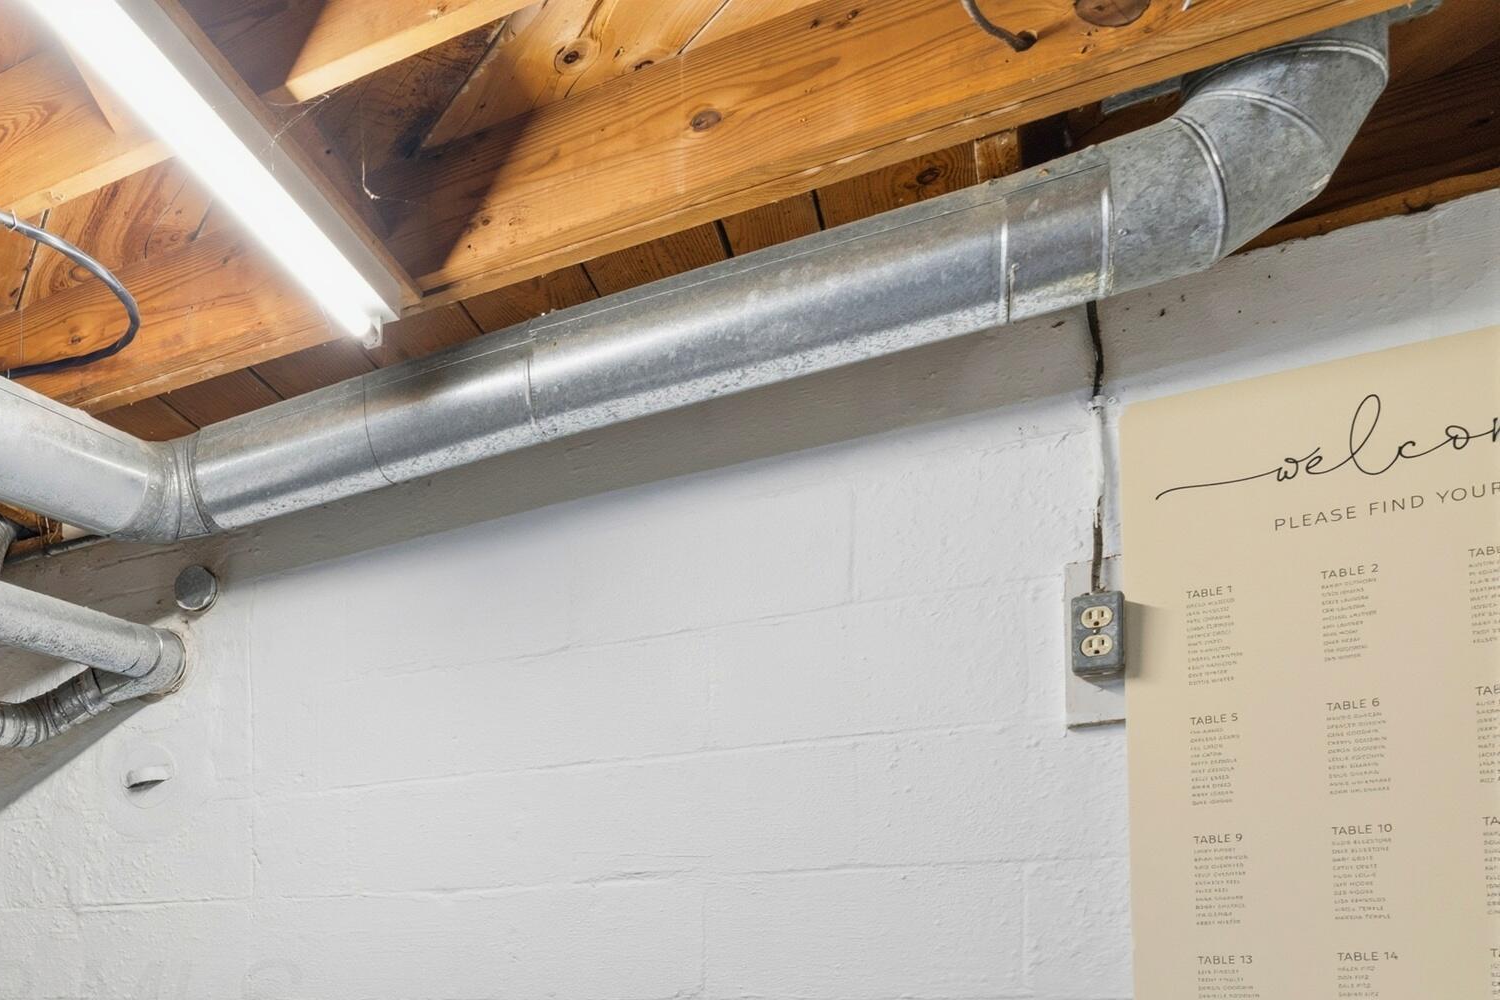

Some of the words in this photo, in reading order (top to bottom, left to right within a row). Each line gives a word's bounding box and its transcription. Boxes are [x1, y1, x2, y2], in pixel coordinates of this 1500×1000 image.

[1274, 505, 1357, 532] PLEASE
[1369, 495, 1425, 516] FIND
[1320, 565, 1365, 580] TABLE
[1371, 563, 1379, 573] 2
[1186, 586, 1223, 599] TABLE
[1226, 585, 1233, 593] 1
[1326, 698, 1367, 711] TABLE
[1371, 697, 1380, 708] 6
[1189, 713, 1227, 726] TABLE
[1331, 824, 1373, 836] TABLE
[1377, 823, 1393, 833] 10
[1193, 833, 1231, 845] TABLE
[1235, 833, 1243, 842] 9
[1197, 955, 1236, 965] TABLE
[1239, 955, 1253, 965] 13
[1336, 951, 1379, 962] TABLE
[1383, 950, 1400, 961] 14
